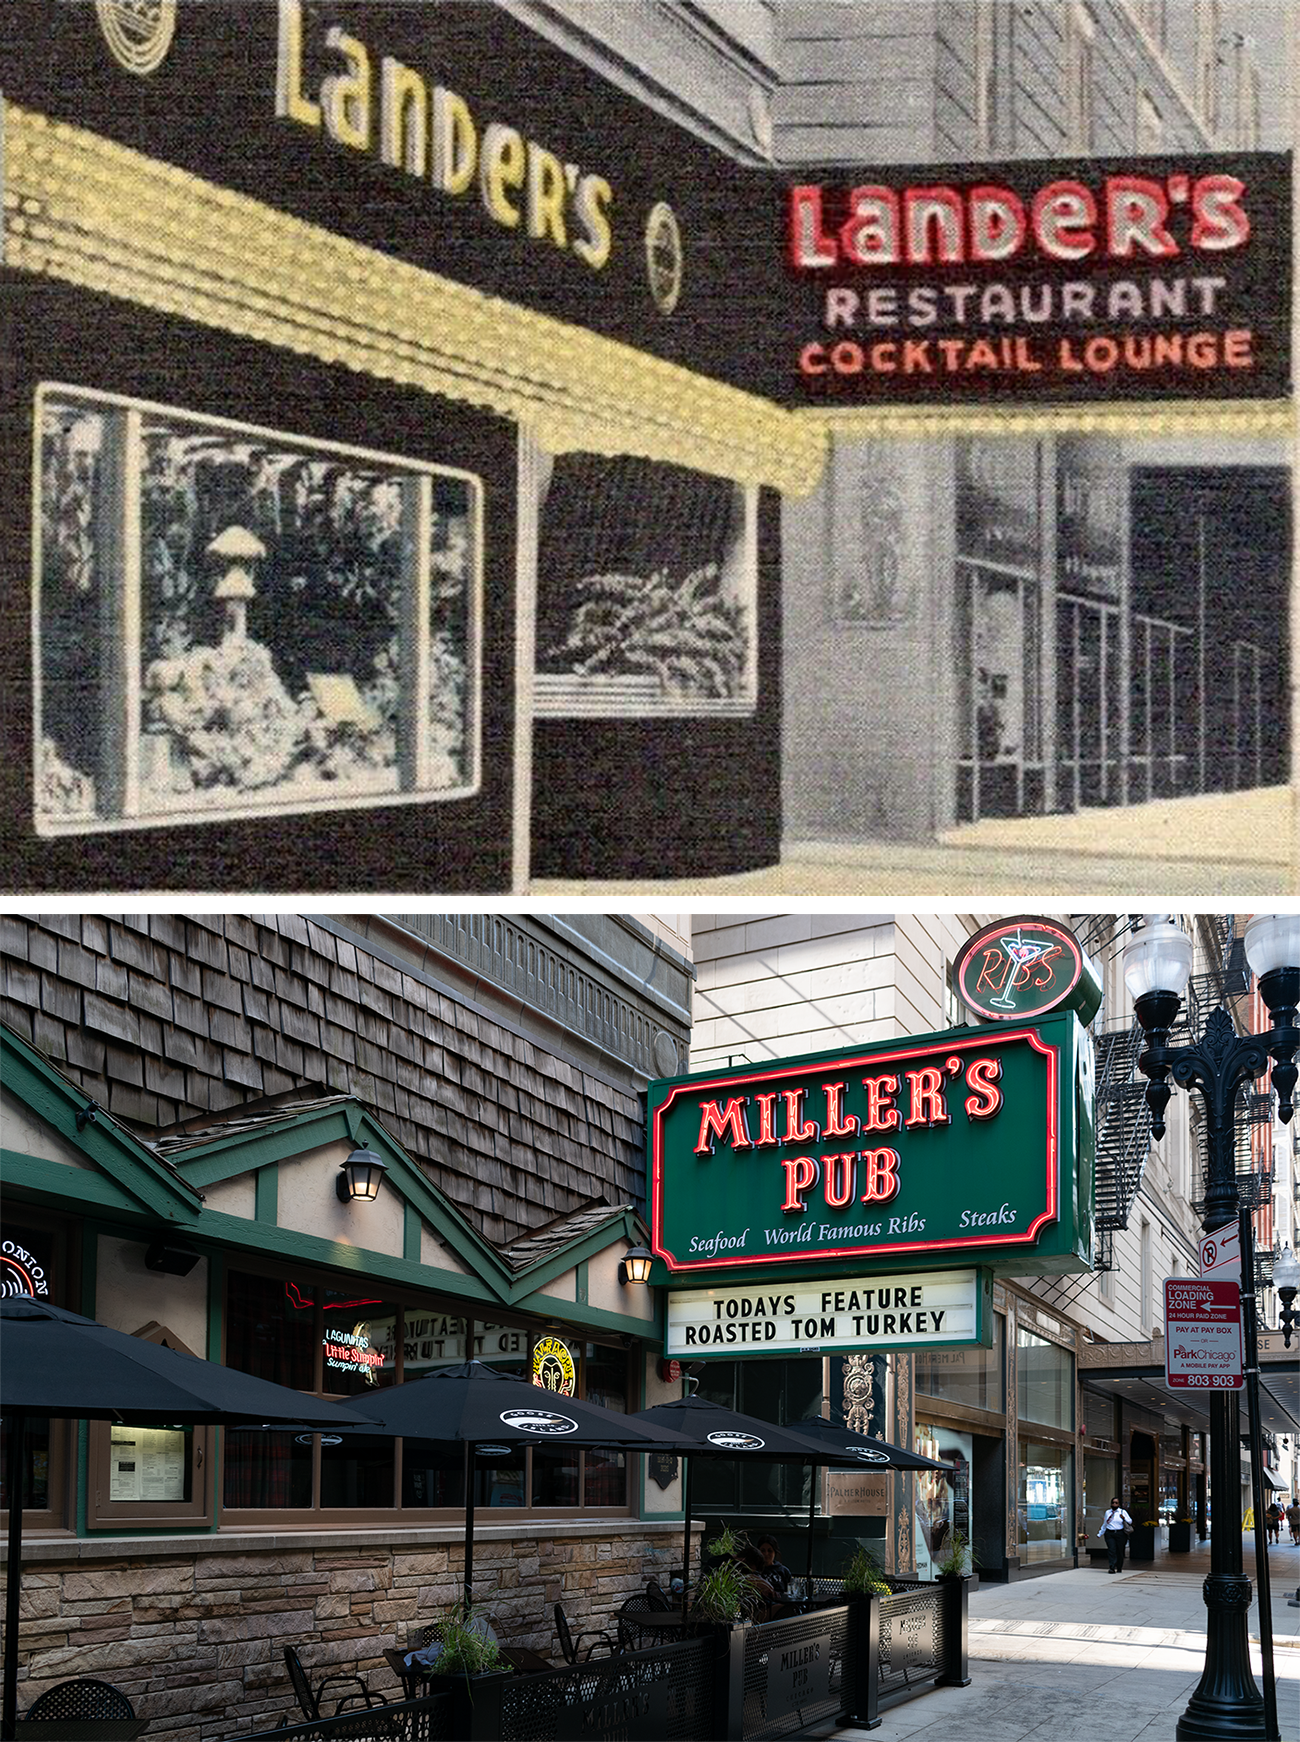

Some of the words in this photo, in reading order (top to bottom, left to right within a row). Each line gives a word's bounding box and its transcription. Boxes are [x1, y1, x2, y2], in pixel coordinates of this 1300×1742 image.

[825, 278, 1226, 327] RESTAURANT
[801, 338, 1042, 374] COCKTAIL
[1060, 331, 1253, 371] LOUNGE
[693, 1055, 1004, 1157] MILLER'S
[781, 1147, 902, 1213] PUB
[689, 1228, 750, 1258] Seafood
[764, 1222, 816, 1245] World
[817, 1222, 882, 1242] Famous
[887, 1212, 926, 1235] Ribs
[959, 1203, 1017, 1228] Steaks
[2, 1241, 48, 1295] ONION
[713, 1295, 795, 1319] TODAYS
[821, 1287, 922, 1312] FEATURE
[1168, 1291, 1214, 1300] LOADING
[1168, 1300, 1197, 1309] ZONE
[325, 1329, 369, 1348] LAGUNITAS
[685, 1321, 776, 1345] ROASTED
[791, 1317, 835, 1339] TOM
[852, 1311, 945, 1336] TURKEY
[326, 1343, 350, 1360] Little
[1174, 1349, 1236, 1362] ParkChicago
[1188, 1375, 1209, 1386] 803
[1213, 1376, 1234, 1386] 903
[780, 1642, 820, 1671] MILLER'S
[792, 1668, 808, 1688] PUB
